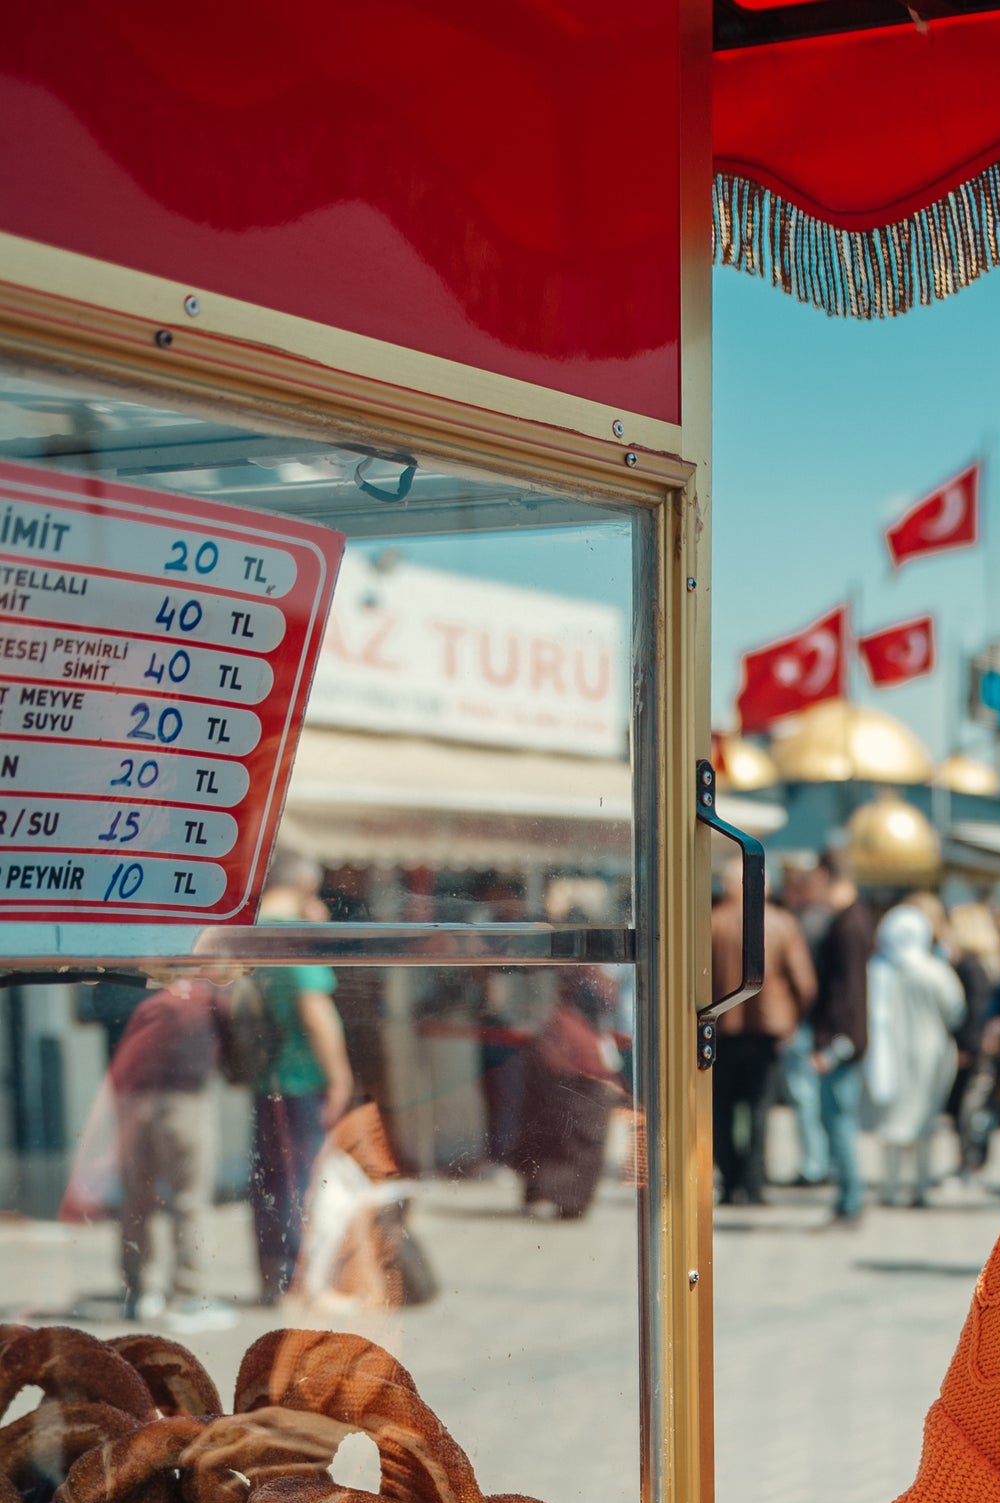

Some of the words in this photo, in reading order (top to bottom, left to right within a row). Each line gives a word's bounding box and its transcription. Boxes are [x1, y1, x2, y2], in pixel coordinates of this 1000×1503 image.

[1, 505, 71, 552] İMİT
[164, 540, 219, 574] 20
[243, 556, 267, 583] TL
[155, 595, 203, 632] 40
[231, 611, 255, 638] TL
[53, 637, 129, 660] PEYNİRLİ
[144, 650, 190, 684] 40
[219, 664, 242, 691] TL
[62, 658, 111, 681] SİMİT
[432, 618, 612, 703] TURU
[20, 687, 85, 710] MEYVE
[127, 702, 183, 743] 20
[207, 717, 231, 743] TL
[22, 711, 74, 732] SUYU
[1, 754, 20, 778] N
[110, 758, 159, 788] 20
[195, 769, 219, 794] TL
[98, 810, 140, 842] 15
[184, 821, 208, 845] TL
[6, 860, 85, 890] PEYNİR
[104, 862, 144, 902] 10
[173, 871, 197, 895] TL
